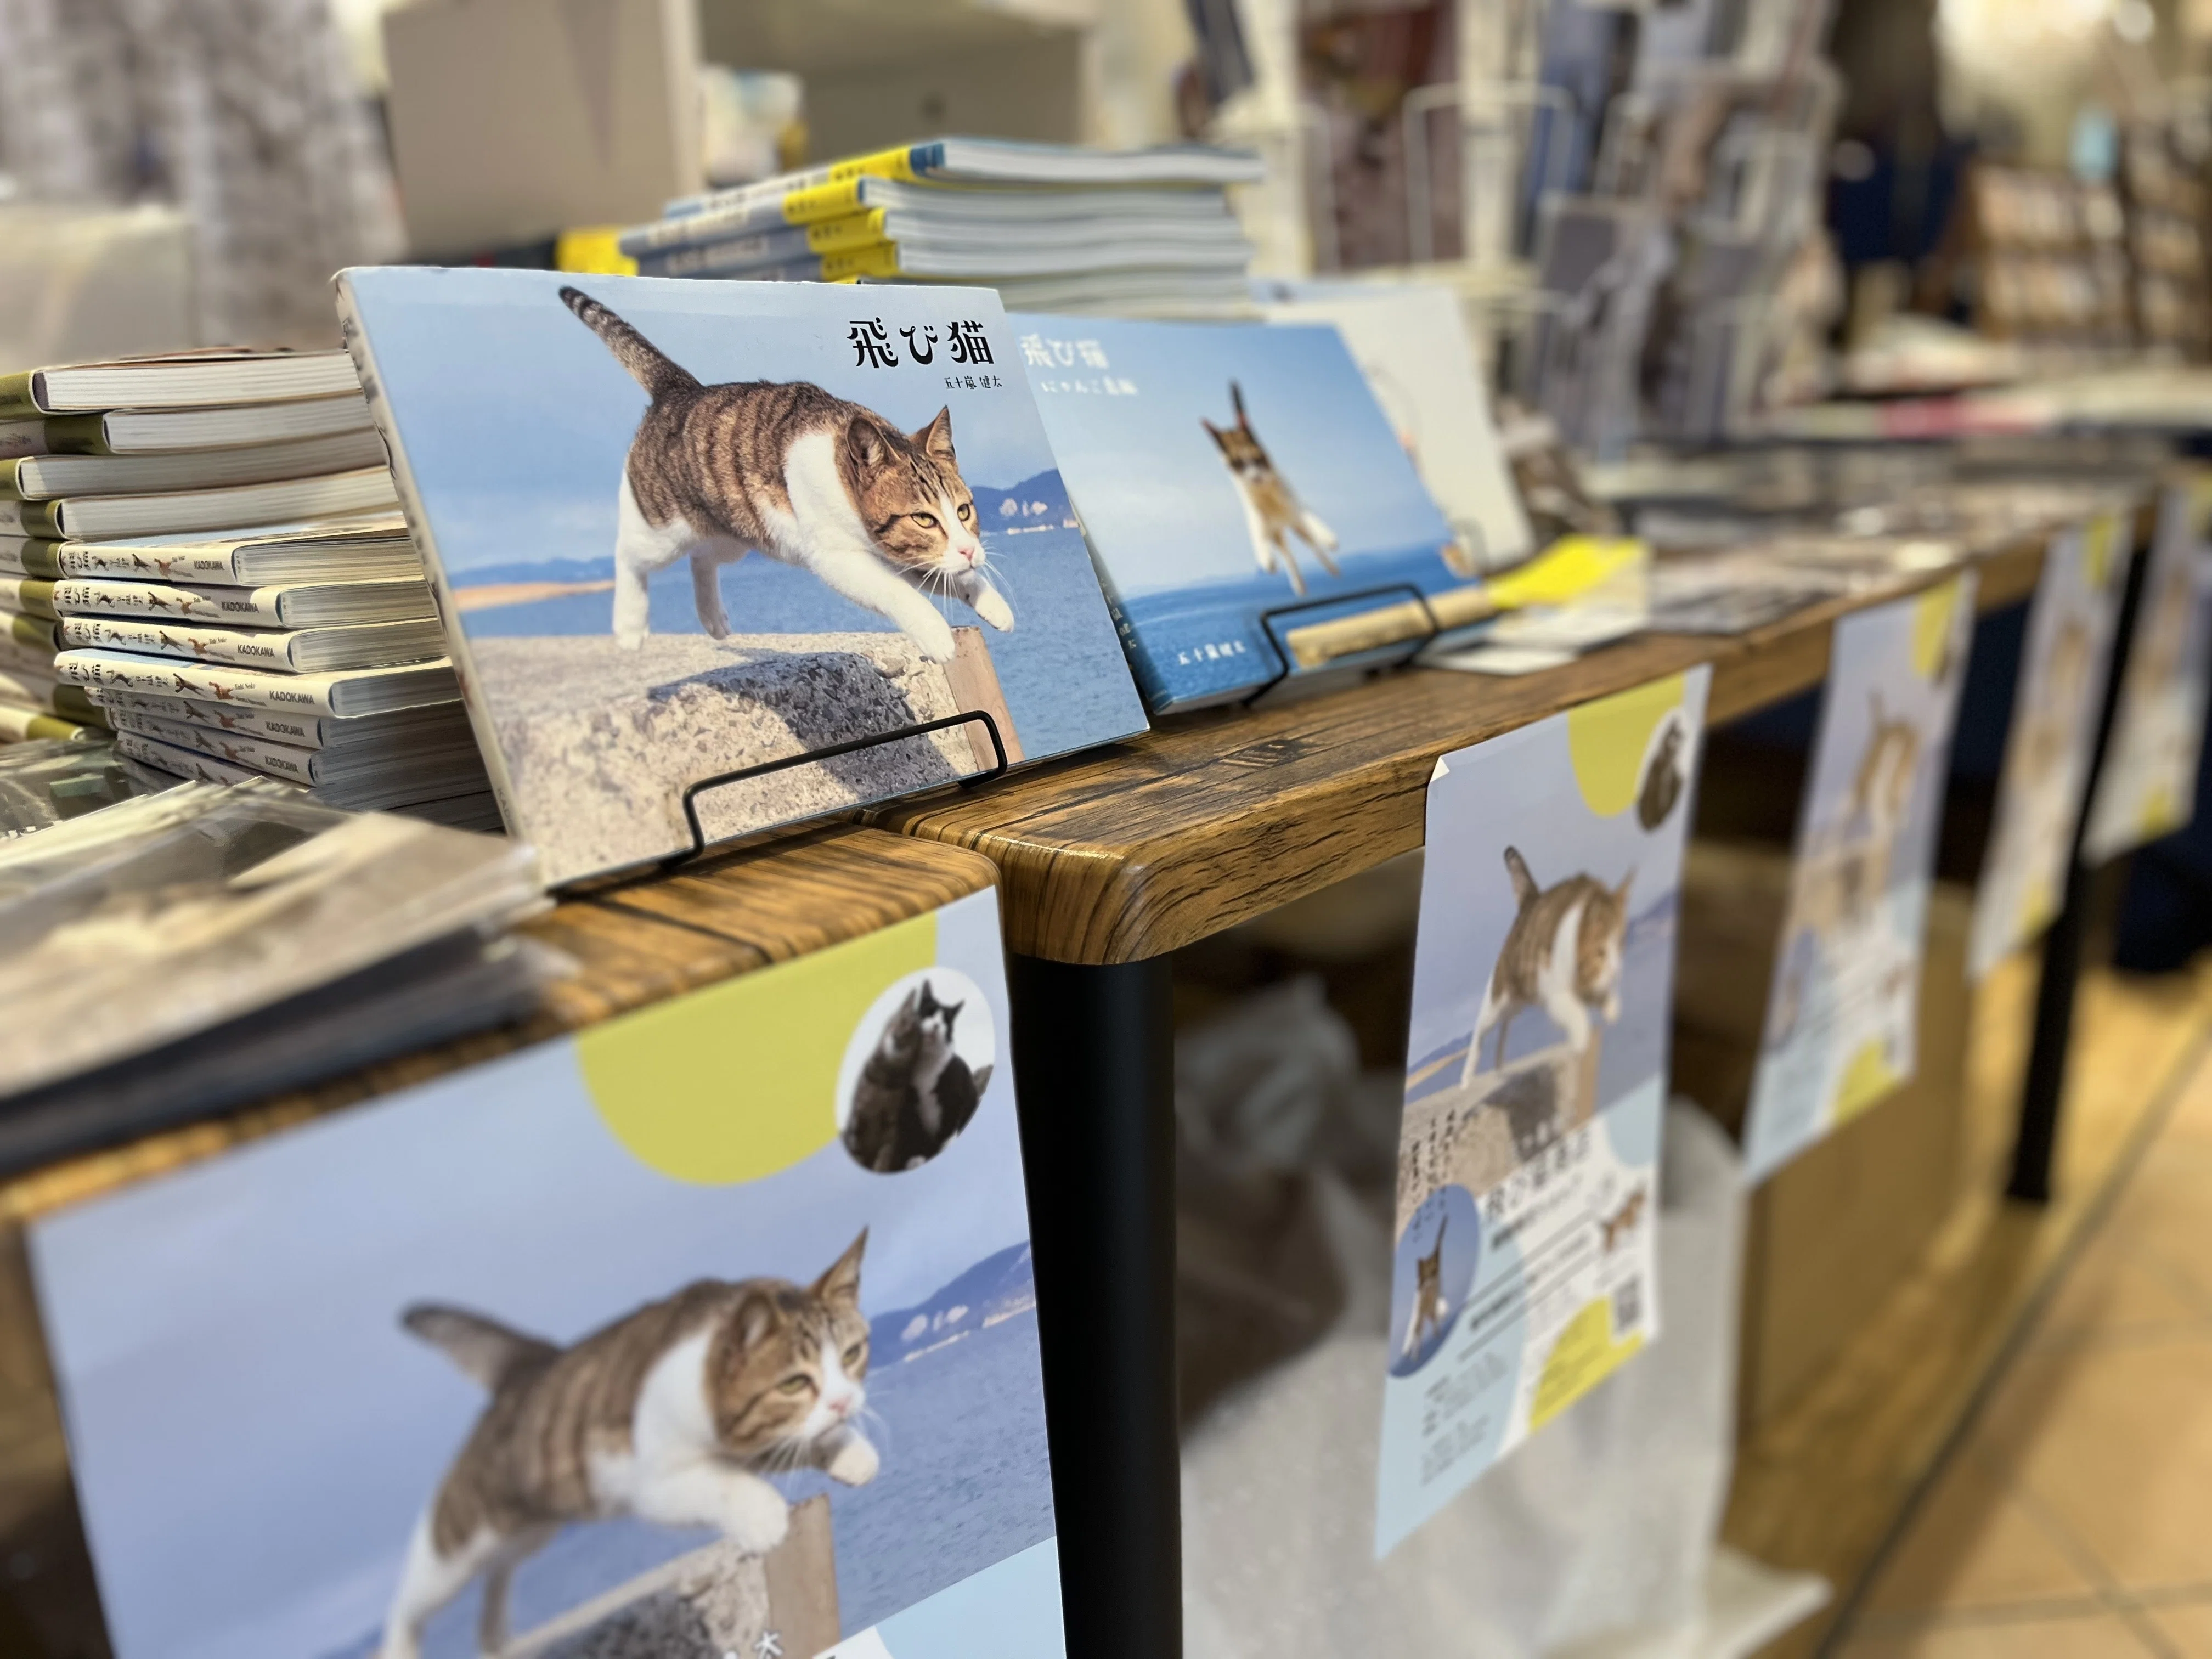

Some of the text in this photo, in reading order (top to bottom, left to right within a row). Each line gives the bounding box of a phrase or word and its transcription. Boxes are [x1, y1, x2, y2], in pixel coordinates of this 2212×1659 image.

[847, 317, 995, 369] 飛び猫
[221, 601, 259, 613] KADOKAWA
[238, 644, 275, 658] KADOKAWA
[269, 690, 315, 705] KADOKAWA
[264, 720, 306, 737] KADOKAWA
